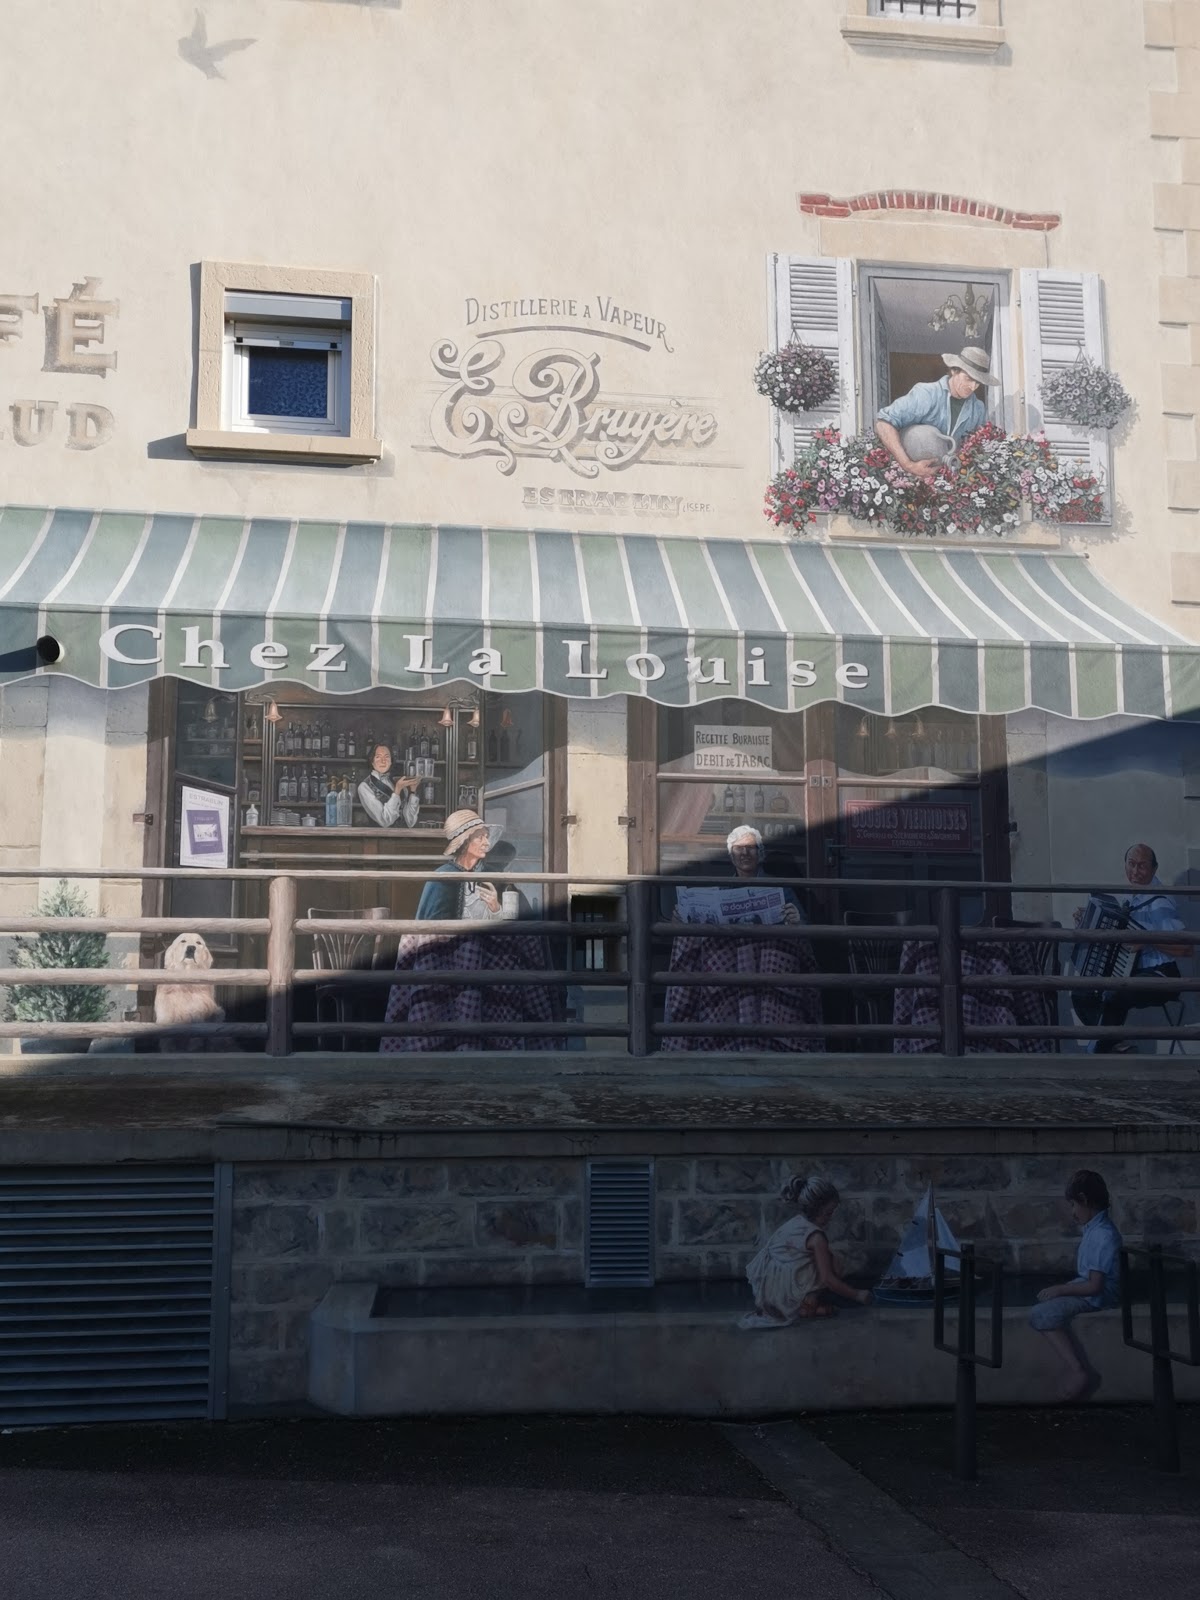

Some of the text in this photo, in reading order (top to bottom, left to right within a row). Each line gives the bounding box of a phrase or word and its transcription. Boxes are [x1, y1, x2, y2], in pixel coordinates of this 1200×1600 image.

[597, 295, 674, 353] VAPEUR
[521, 486, 684, 519] ESTRABLIN
[99, 623, 870, 690] Chez La Louise
[695, 753, 725, 767] DEBIT
[734, 753, 771, 768] TABAC
